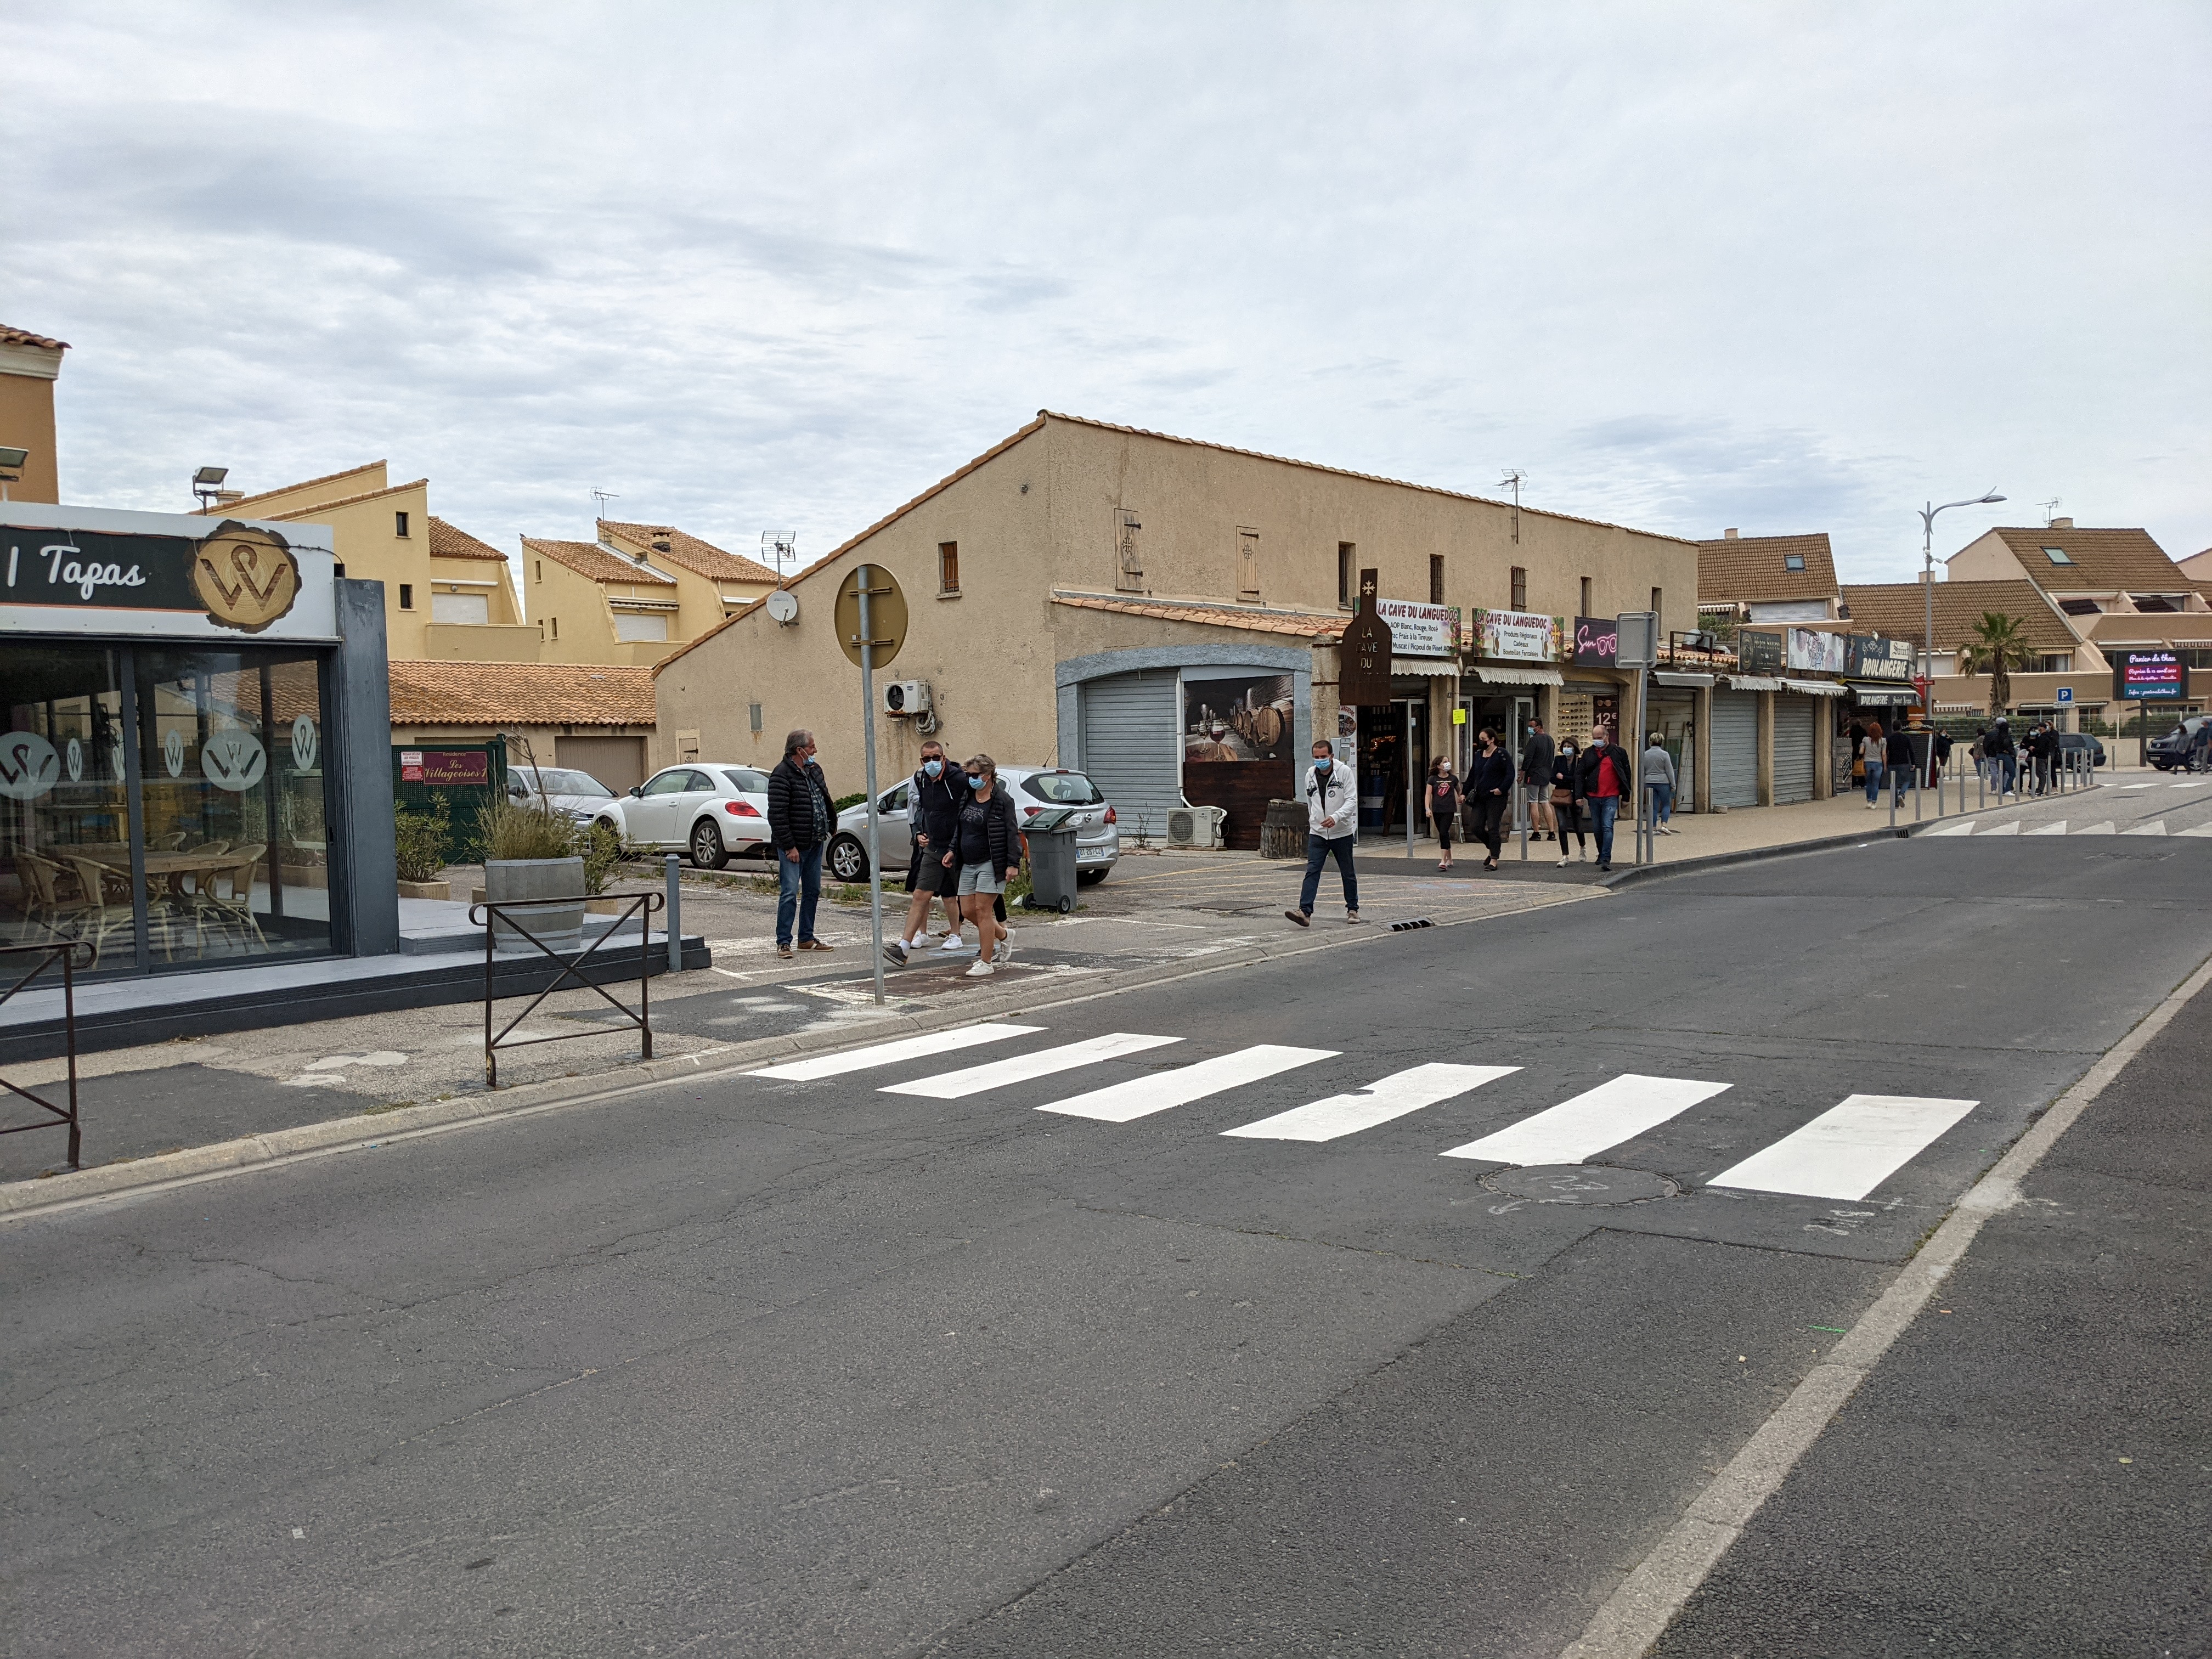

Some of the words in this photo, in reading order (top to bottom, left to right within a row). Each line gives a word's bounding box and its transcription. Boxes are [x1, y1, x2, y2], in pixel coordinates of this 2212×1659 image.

[41, 545, 146, 600] Tapas
[1378, 602, 1386, 616] LA
[1389, 603, 1406, 618] CAVE
[1408, 606, 1417, 619] DU
[1419, 607, 1458, 622] LANGUEDOC
[1477, 611, 1484, 624] LA
[1486, 612, 1502, 625] CAVE
[1503, 614, 1511, 627] DU
[1513, 615, 1547, 629] LANGUEDOC
[1362, 627, 1373, 638] LA
[1414, 623, 1427, 633] Rouge,
[1577, 625, 1596, 654] Sun
[1356, 641, 1378, 652] CAVE
[1410, 643, 1425, 652] Picpoul
[1893, 642, 1909, 656] Saint
[1361, 657, 1372, 669] DU
[2129, 654, 2151, 663] Panier
[2152, 653, 2160, 662] de
[1861, 657, 1908, 678] BOULANGERIE
[1860, 695, 1888, 705] BOULANGERIE
[1893, 696, 1903, 704] Saint
[2061, 690, 2068, 699] P
[448, 759, 463, 769] Les
[425, 768, 479, 782] Villageoises
